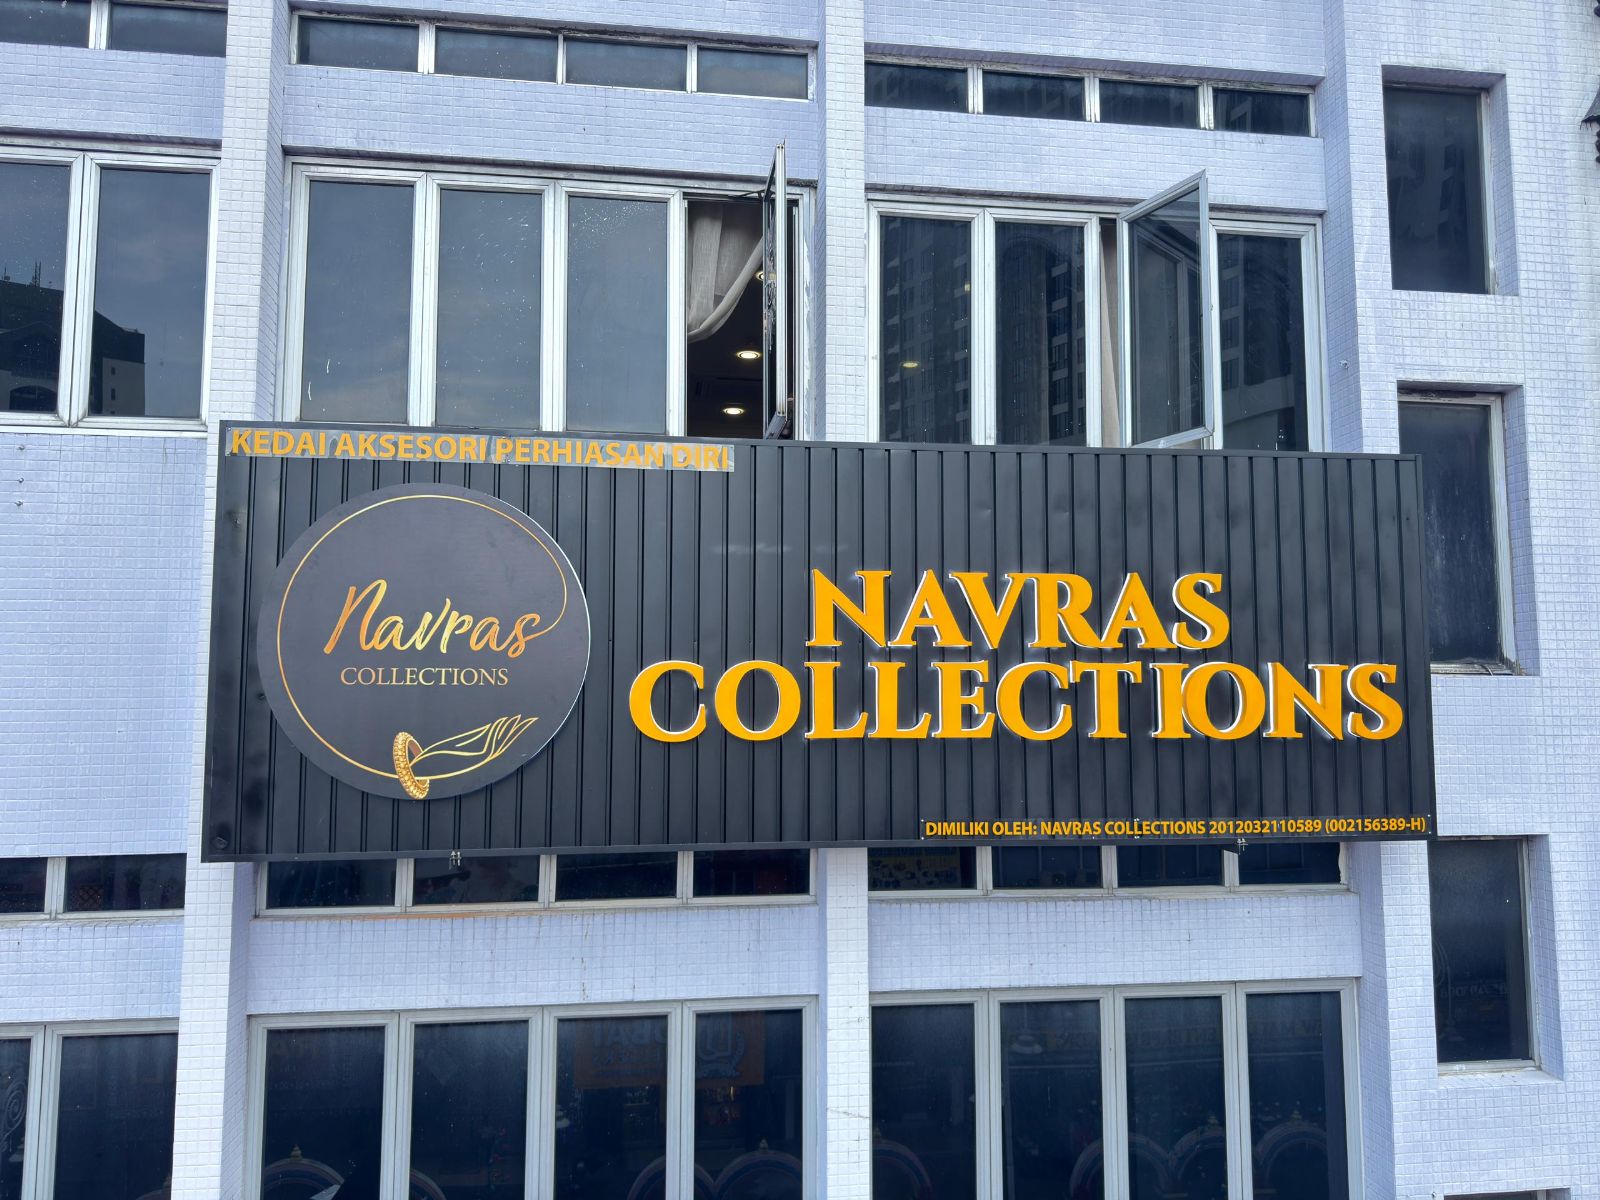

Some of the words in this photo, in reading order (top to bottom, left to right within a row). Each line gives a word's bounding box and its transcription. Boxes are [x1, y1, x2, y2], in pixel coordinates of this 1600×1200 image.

[232, 429, 327, 456] KEDAI
[334, 431, 486, 461] AKSESORI
[497, 438, 664, 468] PERHIASAN
[673, 444, 728, 470] DIRI
[323, 578, 541, 659] Navras
[806, 568, 1230, 649] NAVRAS
[340, 666, 509, 686] COLLECTIONS
[628, 659, 1403, 743] COLLECTIONS
[926, 821, 989, 836] DIMILIKI
[993, 820, 1037, 835] OLEH:
[1041, 820, 1102, 836] NAVRAS
[1105, 819, 1206, 836] COLLECTIONS
[1209, 818, 1322, 834] 2012032110589
[1325, 816, 1426, 833] (002156389-H)
